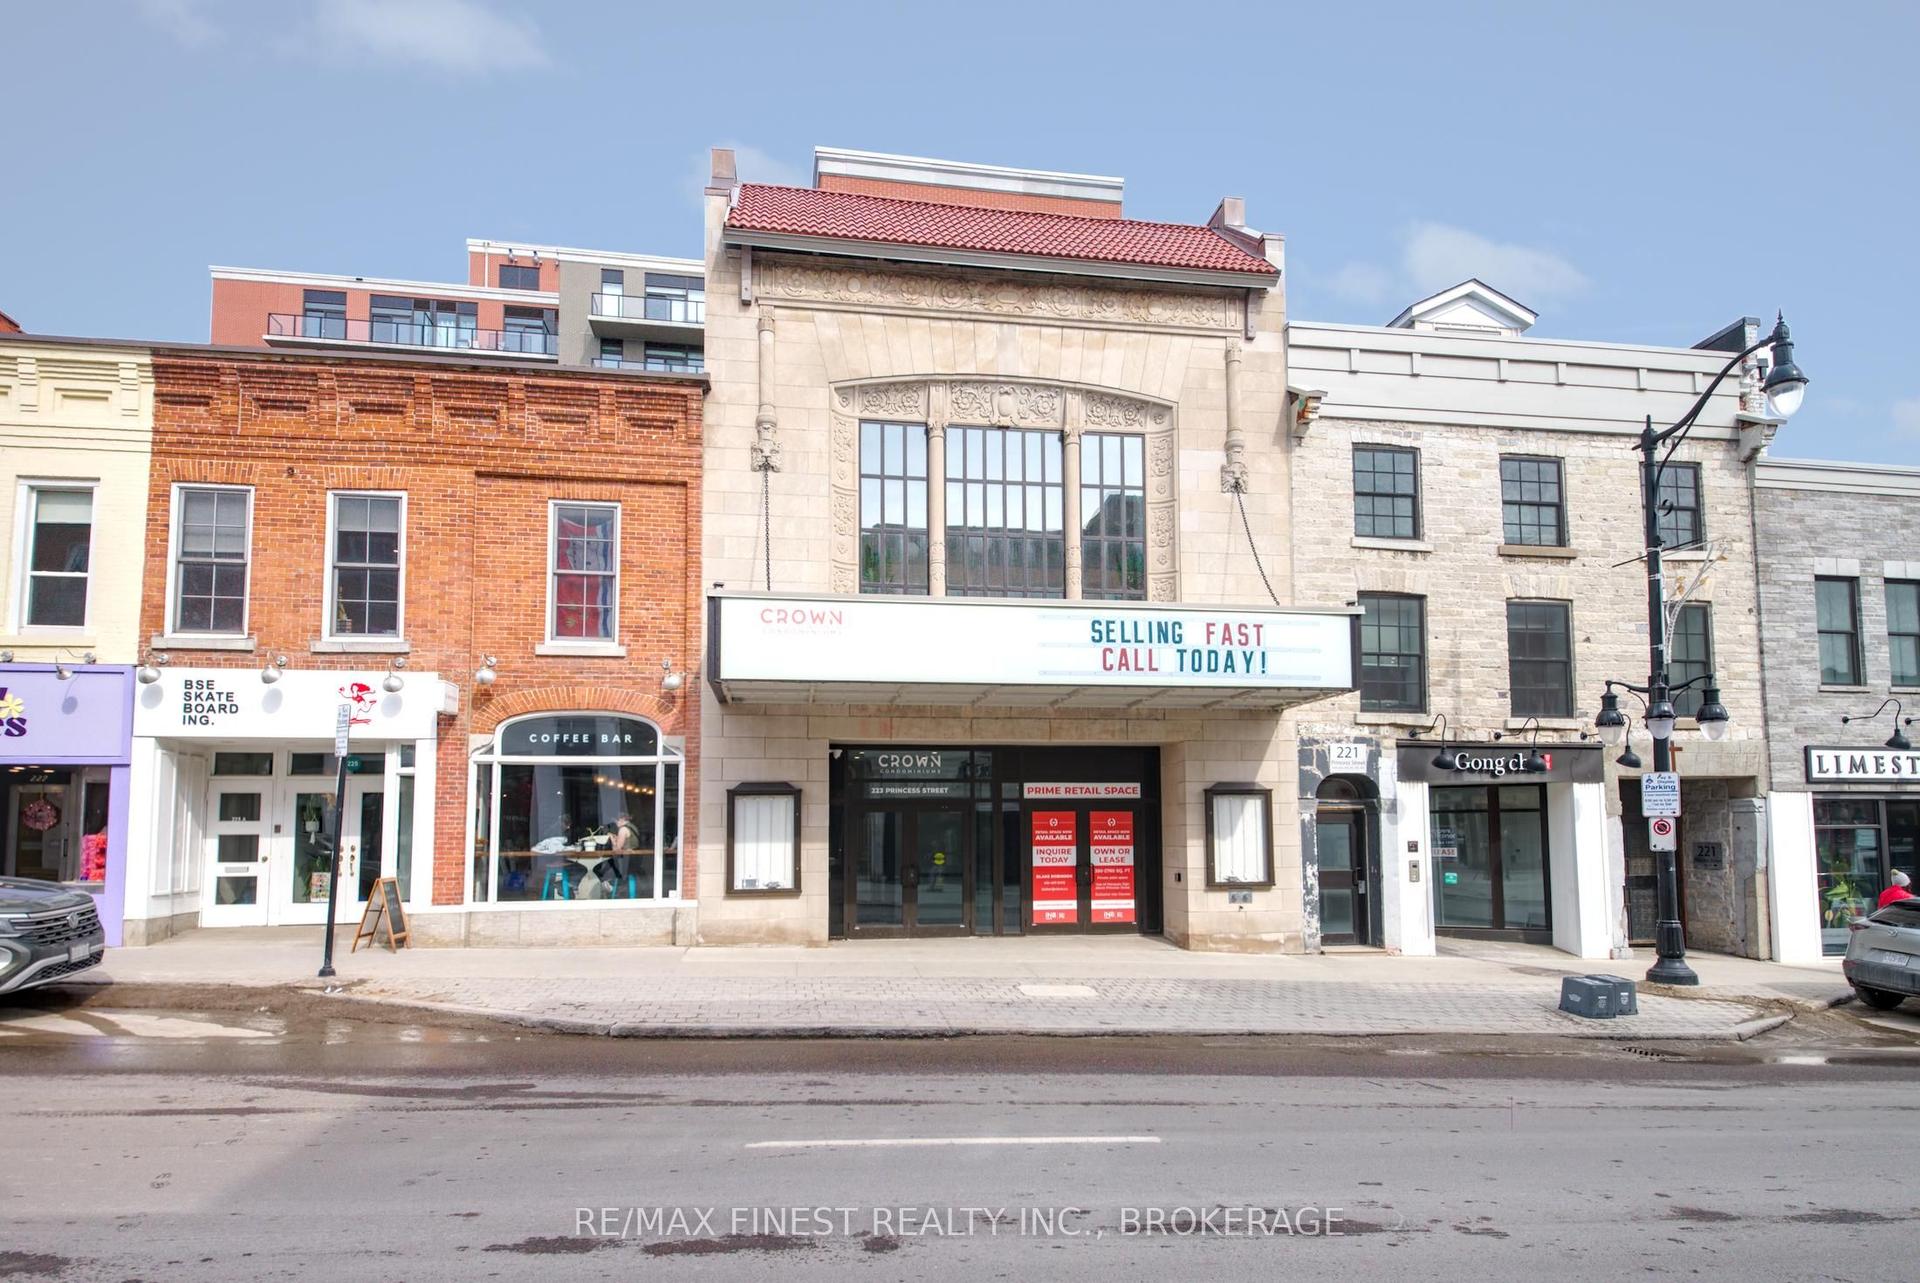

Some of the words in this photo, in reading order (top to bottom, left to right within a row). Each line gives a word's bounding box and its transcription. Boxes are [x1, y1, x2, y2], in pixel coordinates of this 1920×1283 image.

[760, 608, 843, 625] CROWN
[1090, 619, 1184, 645] SELLING
[1205, 622, 1264, 647] FAST
[1102, 647, 1159, 672] CALL
[1176, 649, 1267, 674] TODAY!
[184, 679, 215, 690] BSE
[183, 691, 235, 702] SKATE
[183, 703, 239, 714] BOARD
[182, 714, 215, 726] ING.
[529, 734, 590, 743] COFFEE
[601, 734, 632, 743] BAR
[1336, 746, 1358, 758] 221
[878, 754, 942, 768] CROWN
[1454, 752, 1505, 776] Gong
[1027, 786, 1062, 795] PRIME
[1064, 786, 1102, 795] RETAIL
[1104, 786, 1139, 795] SPACE
[1645, 784, 1676, 793] Parking
[1036, 848, 1072, 856] INQUIRE
[1697, 846, 1715, 857] 221
